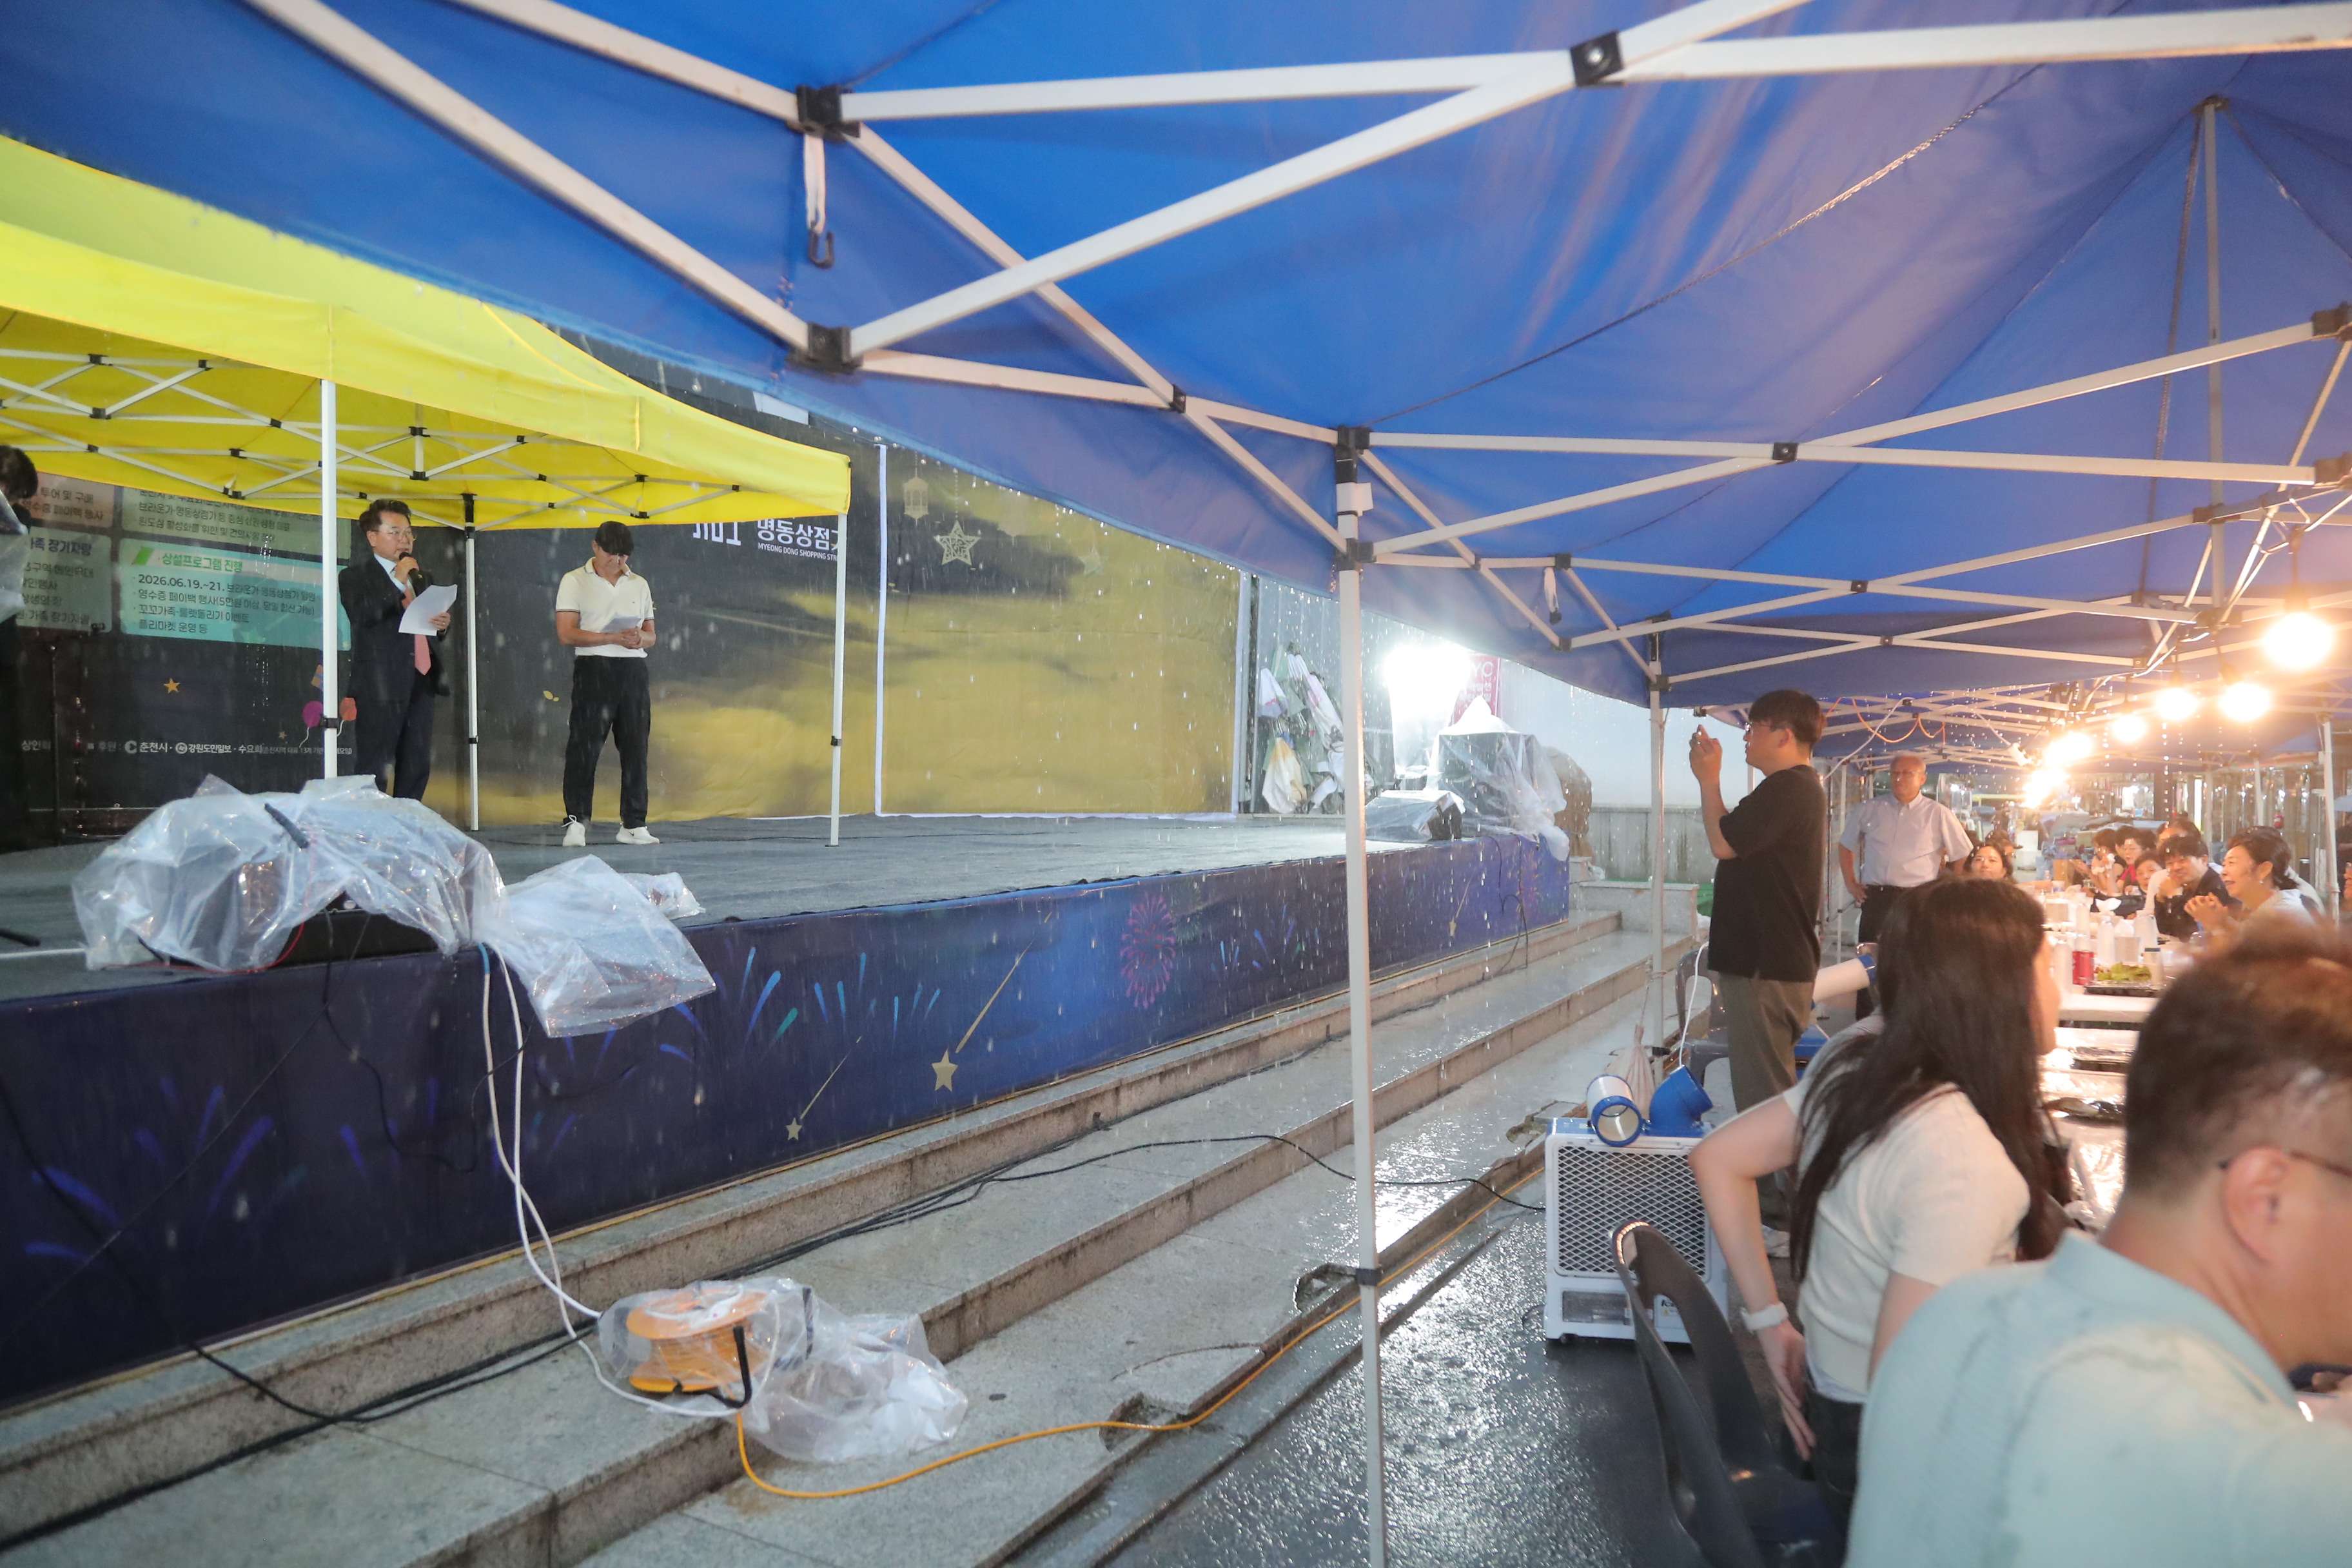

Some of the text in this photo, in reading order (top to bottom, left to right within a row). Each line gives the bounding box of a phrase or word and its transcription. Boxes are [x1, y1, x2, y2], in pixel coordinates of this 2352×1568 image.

[48, 538, 92, 556] 장기자랑
[758, 542, 783, 553] MYEONG
[783, 546, 799, 556] DONG
[799, 549, 827, 560] SHOPPING
[162, 553, 242, 573] 상설프로그램 진행
[139, 574, 224, 591] 2026.06.19.~21.
[139, 589, 166, 601] 영수증
[169, 591, 196, 603] 페이백
[139, 619, 208, 634] 플리마켓 운영 등
[139, 742, 168, 752] 춘천시
[188, 743, 232, 753] 강원도민일보
